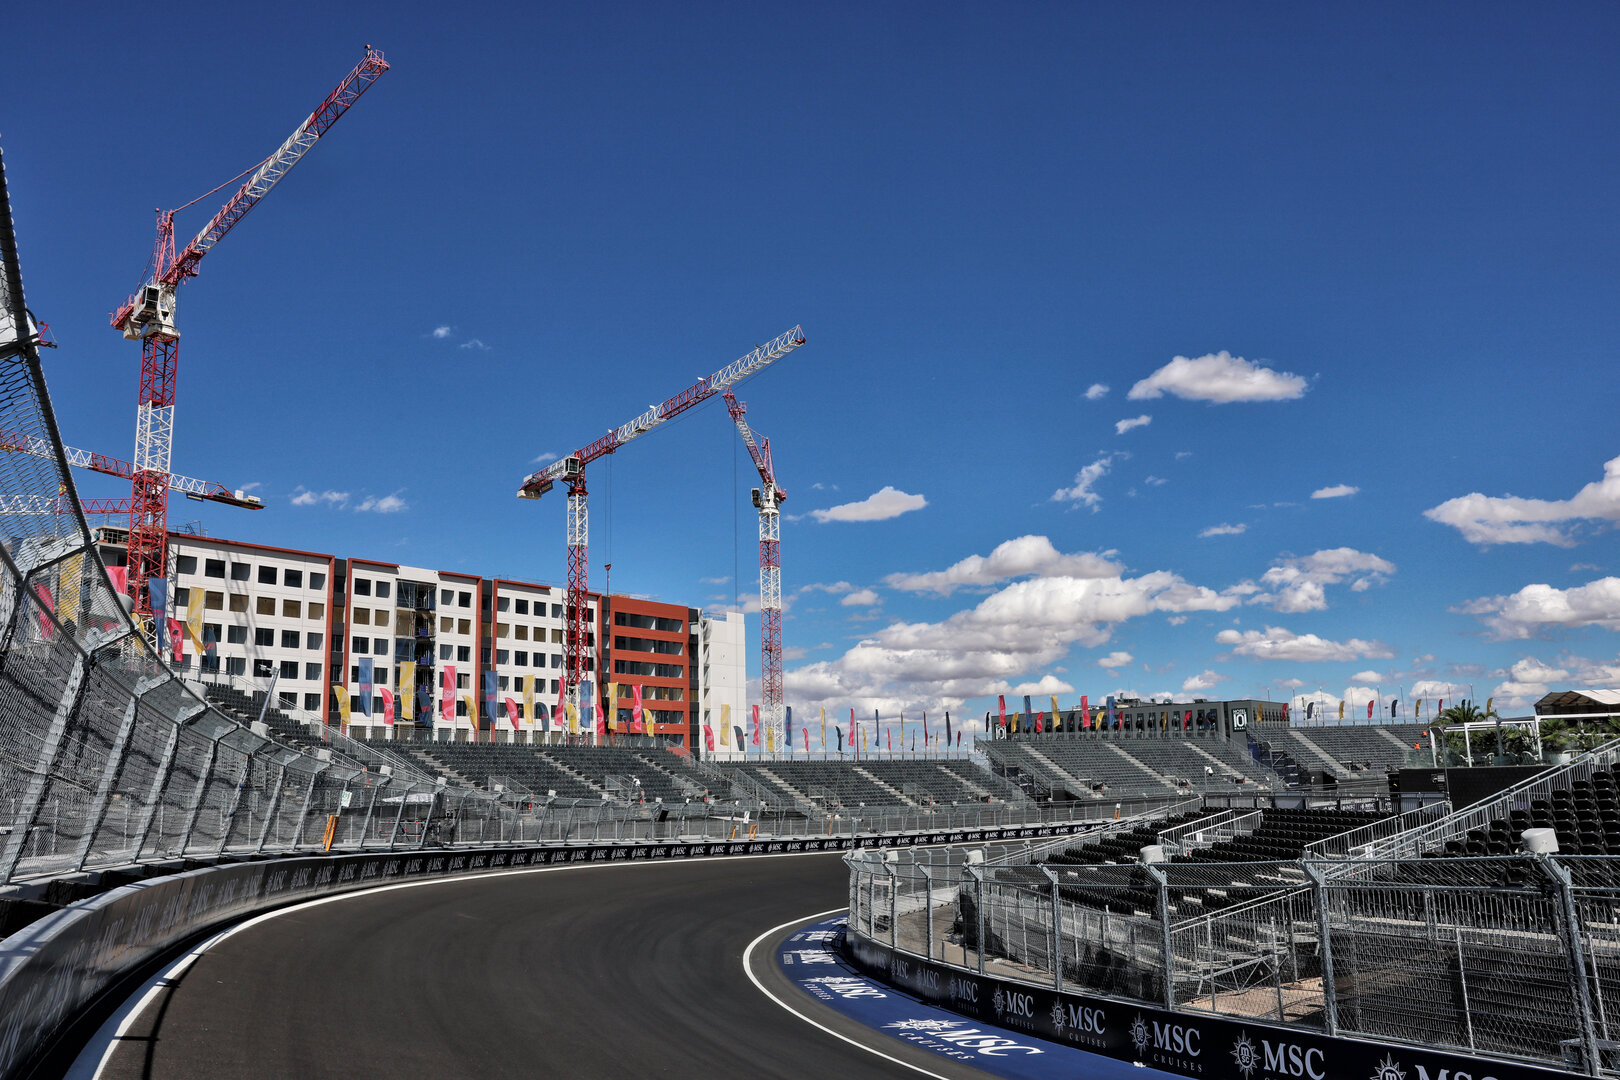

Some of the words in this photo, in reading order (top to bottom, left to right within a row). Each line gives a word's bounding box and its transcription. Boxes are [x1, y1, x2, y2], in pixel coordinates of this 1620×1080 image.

[616, 848, 628, 857] MSC
[636, 848, 648, 856] MSC
[656, 847, 666, 856] MSC
[675, 846, 686, 855] MSC
[695, 846, 706, 854] MSC
[715, 845, 726, 853] MSC
[754, 844, 764, 852] MSC
[772, 843, 783, 851] MSC
[494, 854, 507, 865] MSC
[516, 852, 528, 863] MSC
[536, 852, 547, 862] MSC
[556, 851, 567, 860] MSC
[576, 850, 588, 860] MSC
[596, 850, 608, 858] MSC
[896, 959, 909, 980] MSC
[922, 968, 940, 990] MSC
[958, 978, 978, 1002] MSC
[1006, 990, 1034, 1018] MSC
[1068, 1004, 1106, 1034] MSC
[925, 1028, 1045, 1057] MSC
[1069, 1032, 1107, 1048] CRUISES
[1152, 1020, 1201, 1057] MSC
[898, 1032, 975, 1060] CRUISES
[1153, 1053, 1202, 1073] CRUISES
[1261, 1040, 1326, 1080] MSC
